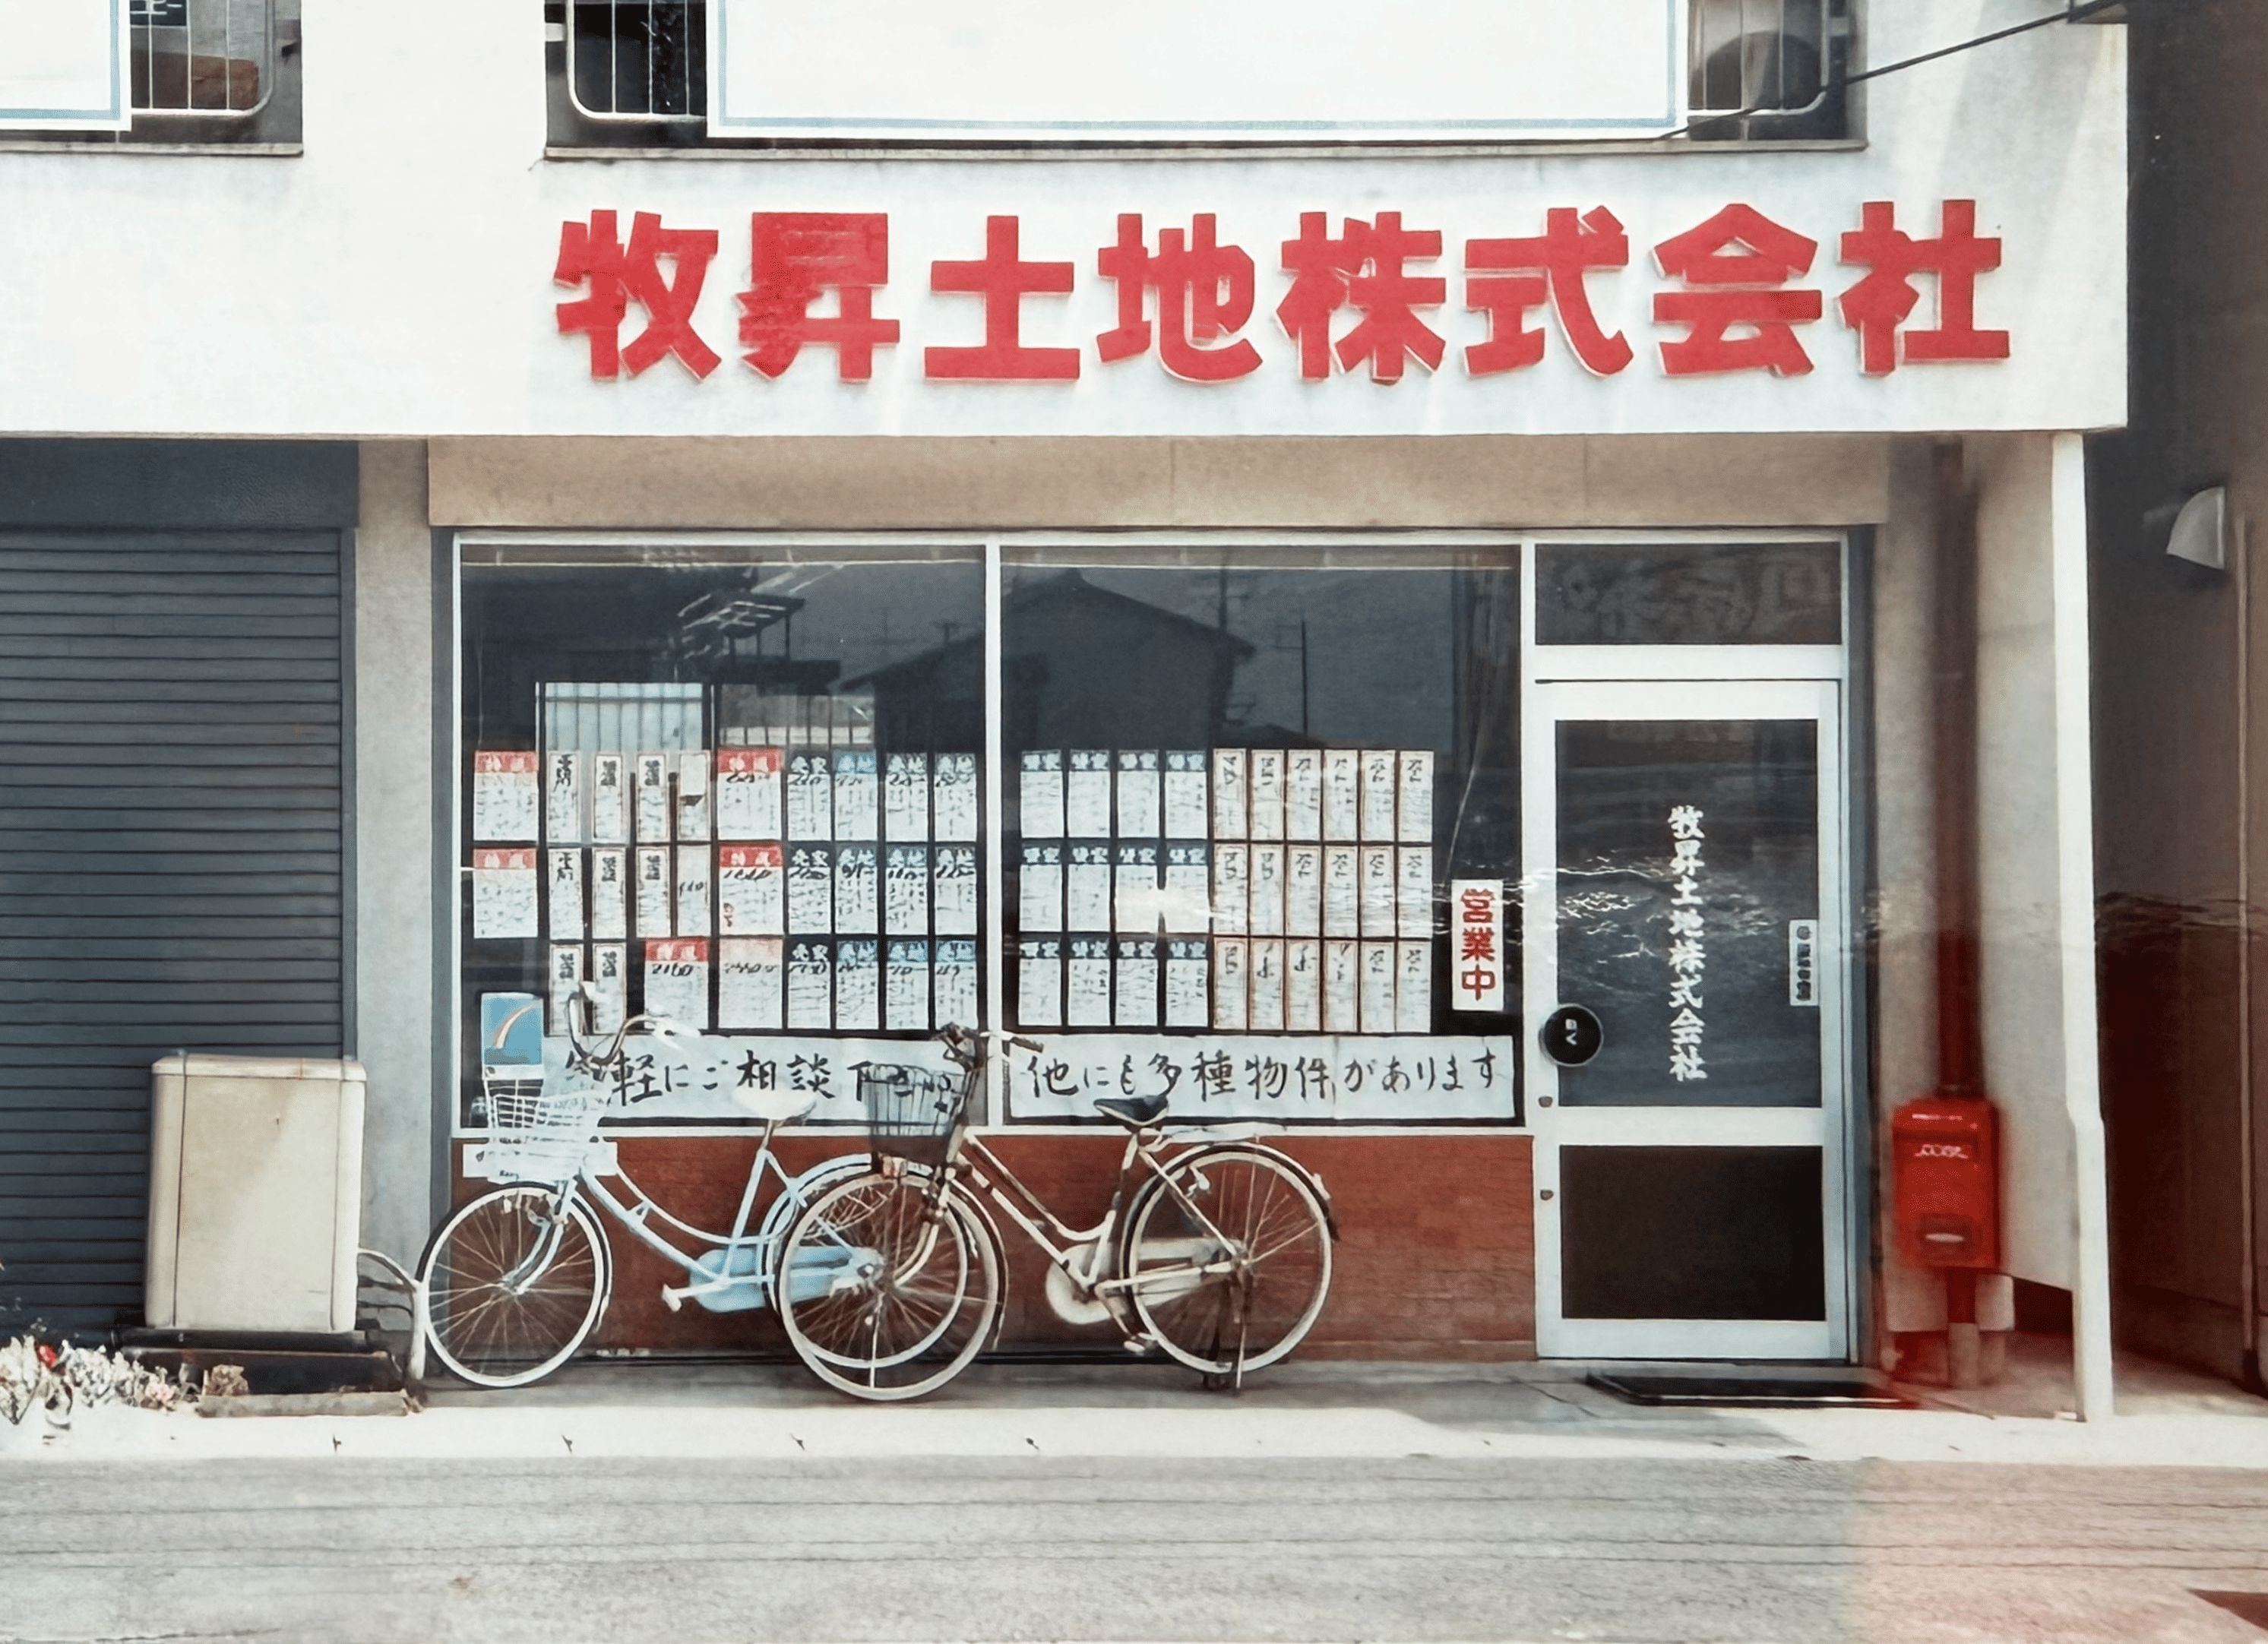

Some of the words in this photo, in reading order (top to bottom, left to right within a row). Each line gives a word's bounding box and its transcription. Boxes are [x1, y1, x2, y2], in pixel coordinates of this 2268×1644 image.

[555, 201, 2009, 383] 牧昇土地株式会社
[1461, 888, 1495, 1001] 営業中
[1027, 1048, 1496, 1102] 他にも多種物件があります
